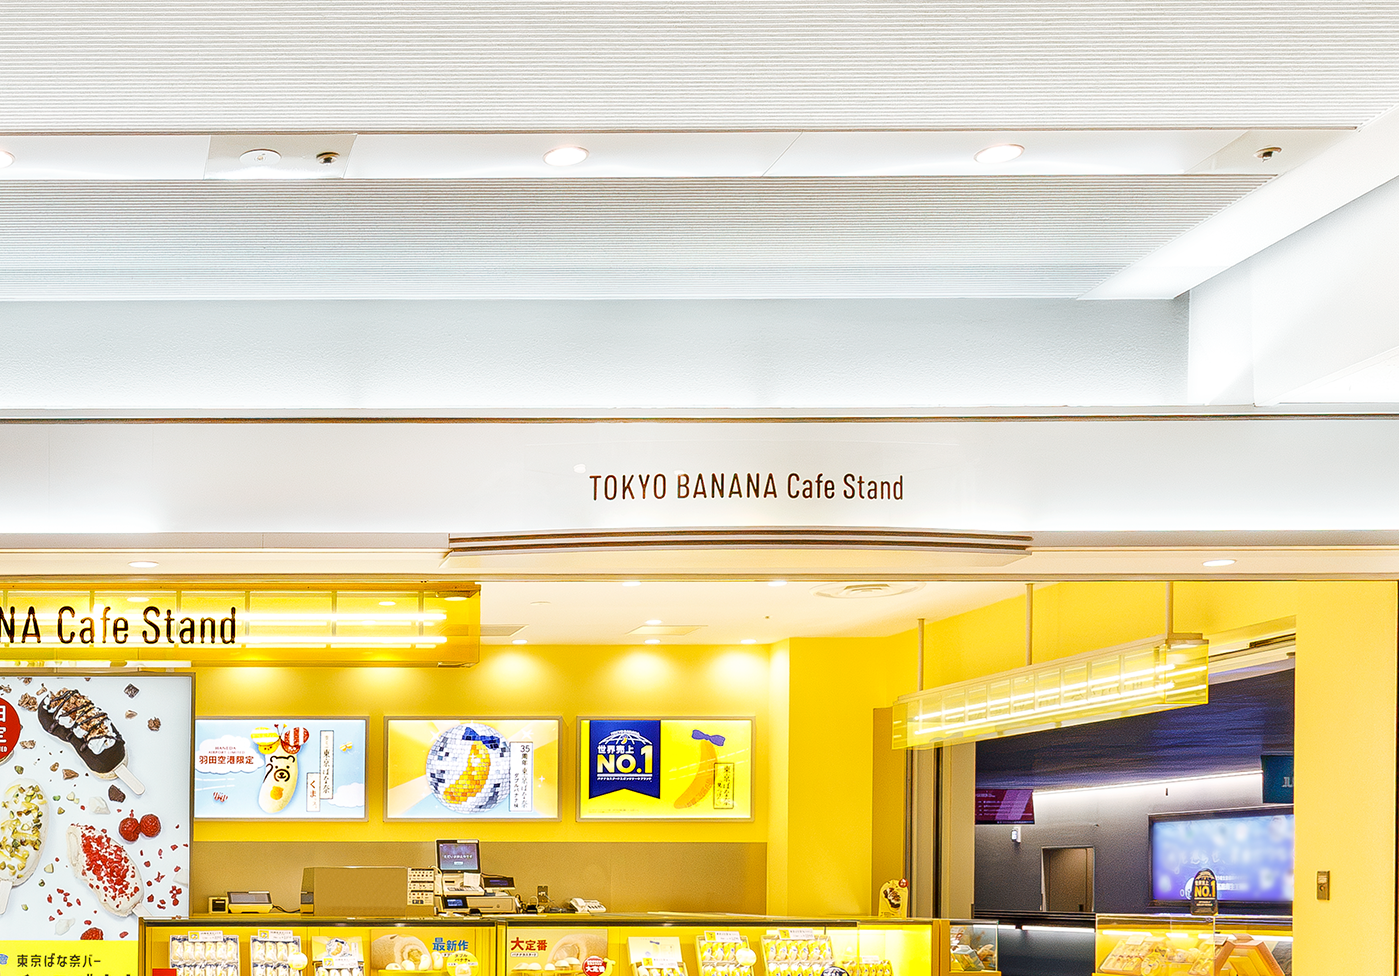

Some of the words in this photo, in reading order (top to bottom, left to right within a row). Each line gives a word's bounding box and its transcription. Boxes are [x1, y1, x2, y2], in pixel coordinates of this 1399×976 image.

[589, 474, 667, 500] TOKYO
[677, 472, 778, 499] BANANA
[787, 472, 836, 499] Cafe
[843, 473, 904, 500] Stand
[57, 605, 130, 644] Cafe
[142, 605, 237, 644] Stand
[198, 755, 254, 765] 羽田空港限定
[597, 745, 653, 773] NO.1
[1194, 880, 1216, 898] NO.1
[431, 937, 469, 952] 最新作
[510, 937, 548, 952] 大定番
[16, 953, 101, 968] 東京ばな奈バー
